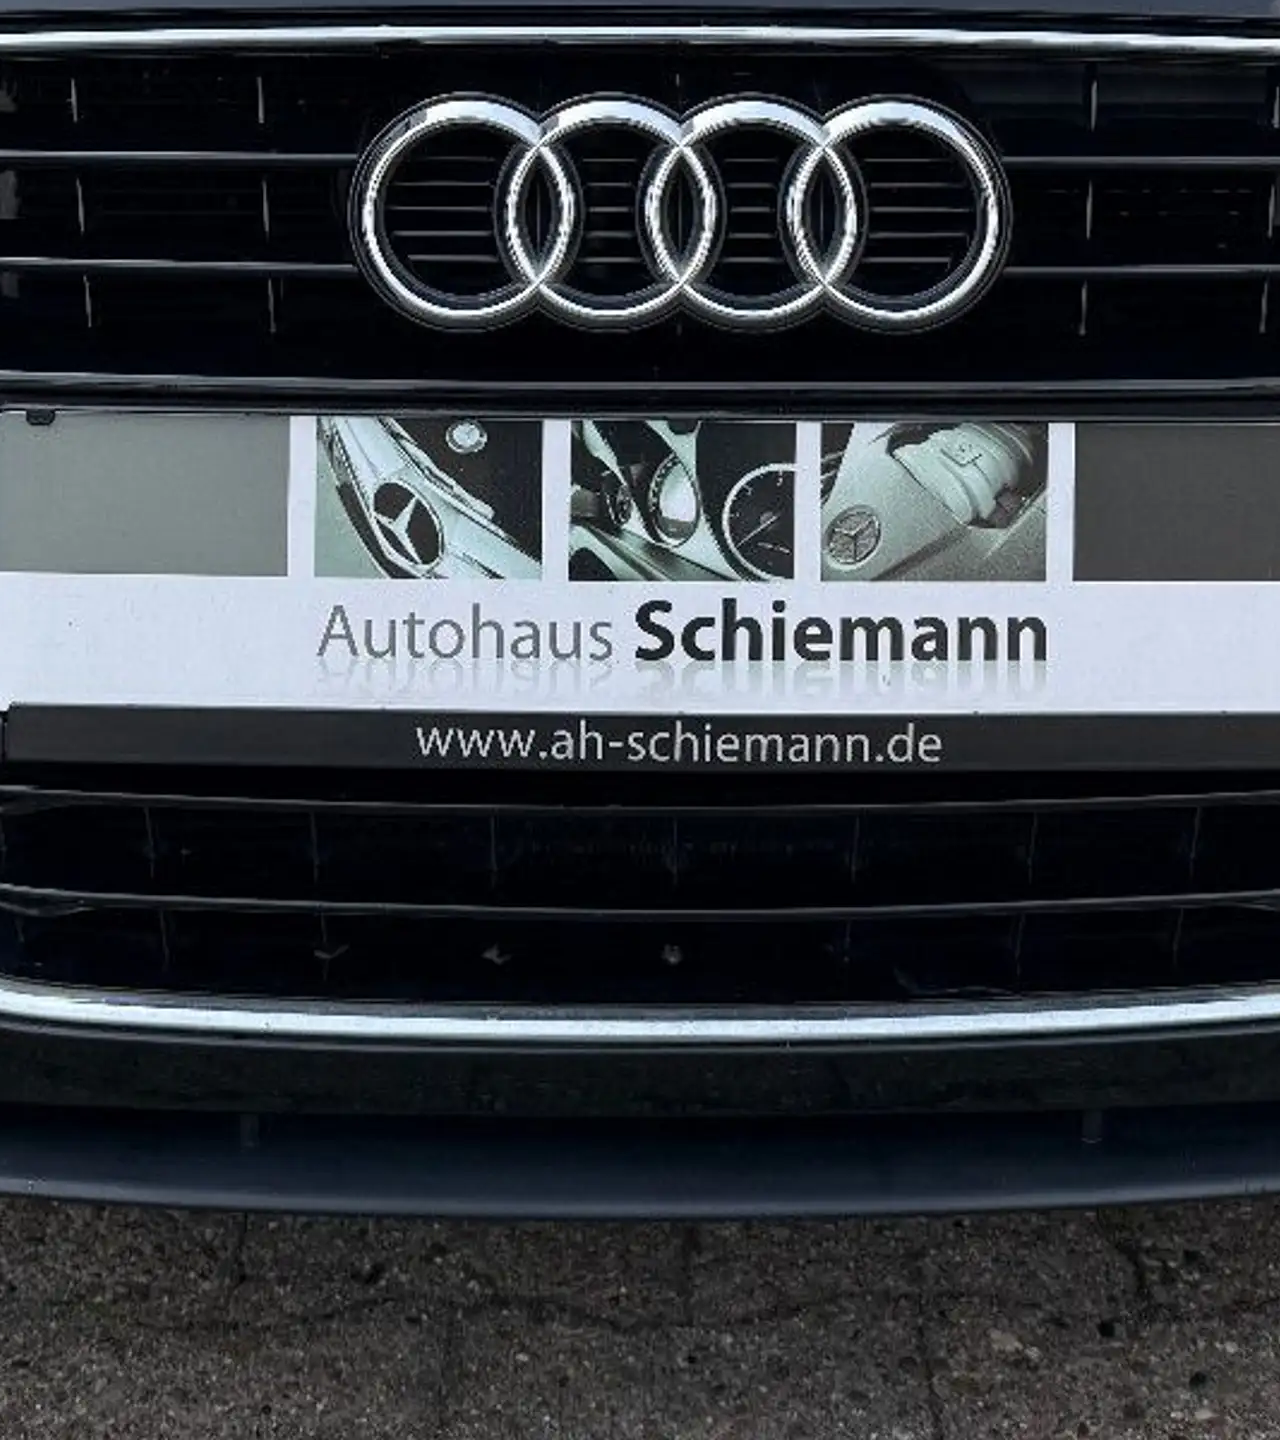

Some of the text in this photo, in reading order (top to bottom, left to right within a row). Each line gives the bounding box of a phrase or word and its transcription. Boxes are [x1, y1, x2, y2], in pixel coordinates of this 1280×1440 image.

[317, 598, 1047, 662] Autohaus Schiemann
[417, 719, 942, 763] www.ah-schiemann.de
